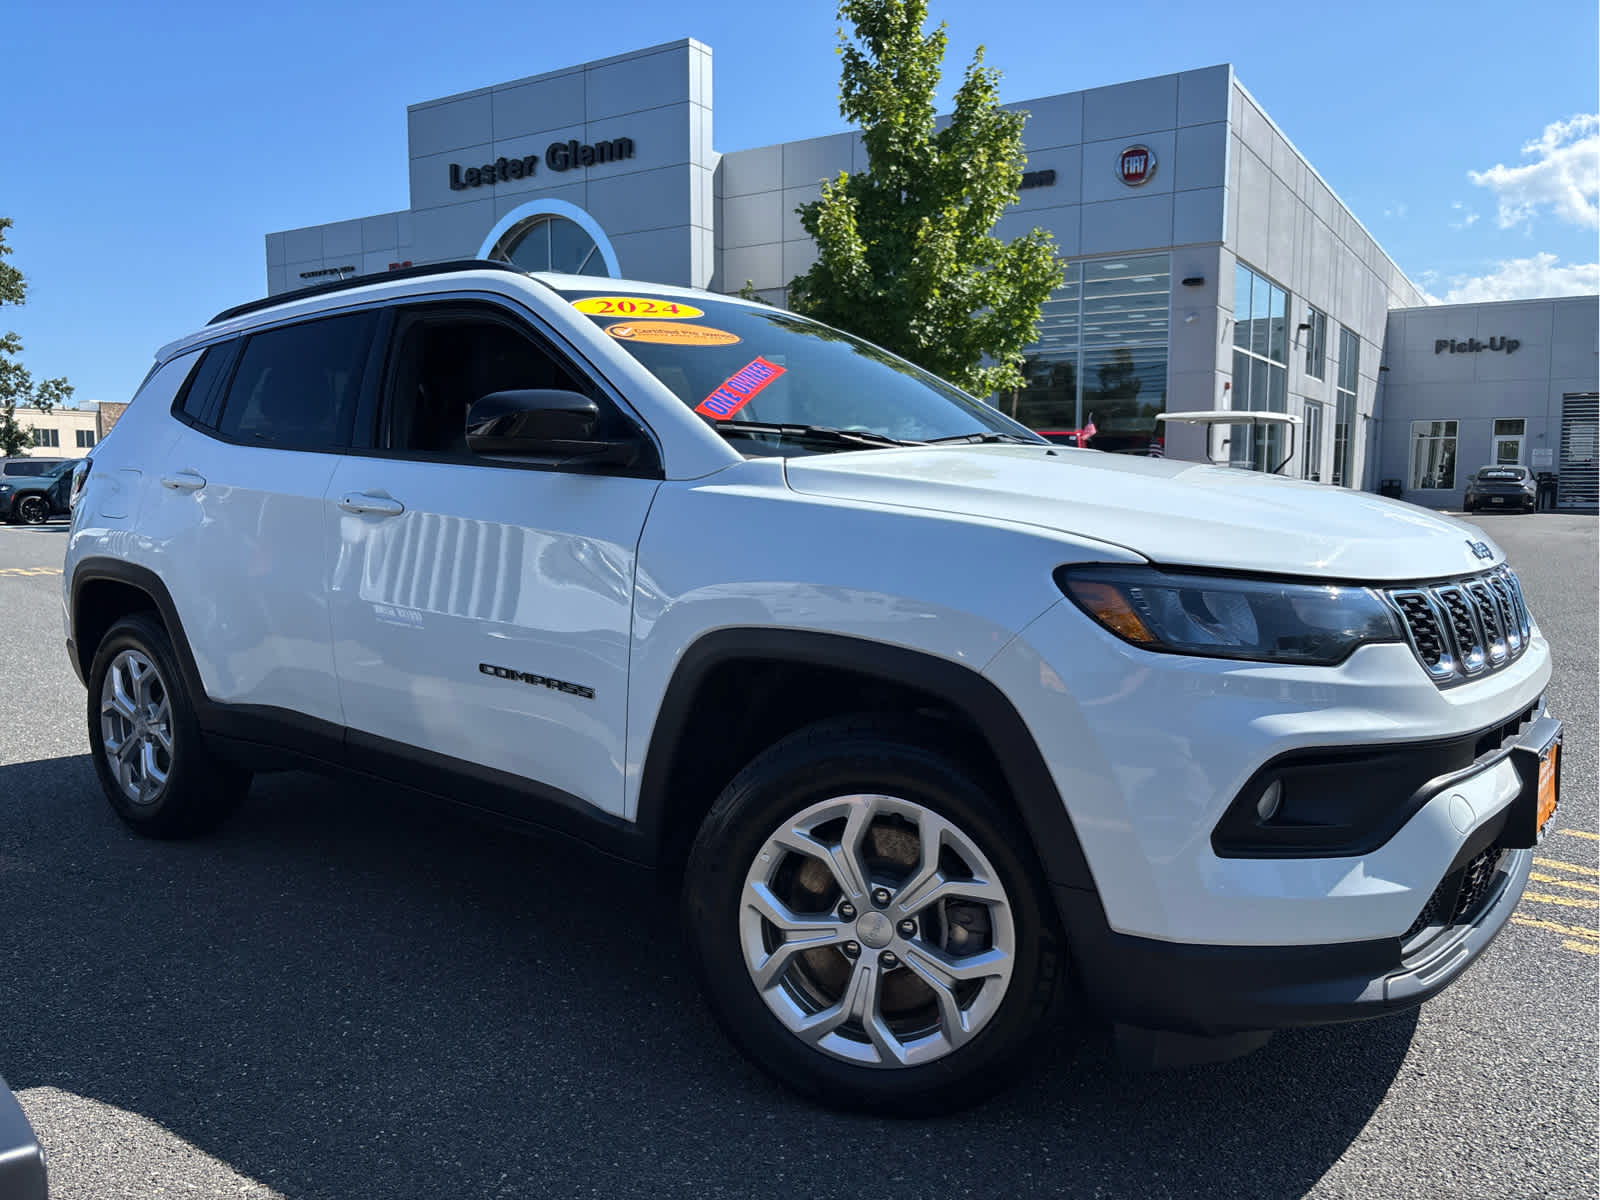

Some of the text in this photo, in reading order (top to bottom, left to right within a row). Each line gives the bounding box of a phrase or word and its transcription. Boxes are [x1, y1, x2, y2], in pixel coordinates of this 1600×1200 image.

[448, 136, 635, 191] Lester Glenn
[1124, 154, 1147, 175] FIAT
[595, 300, 681, 315] 2024
[1434, 336, 1521, 354] Pick-Up
[703, 361, 776, 415] ONE OWNER
[478, 662, 596, 700] COMPASS
